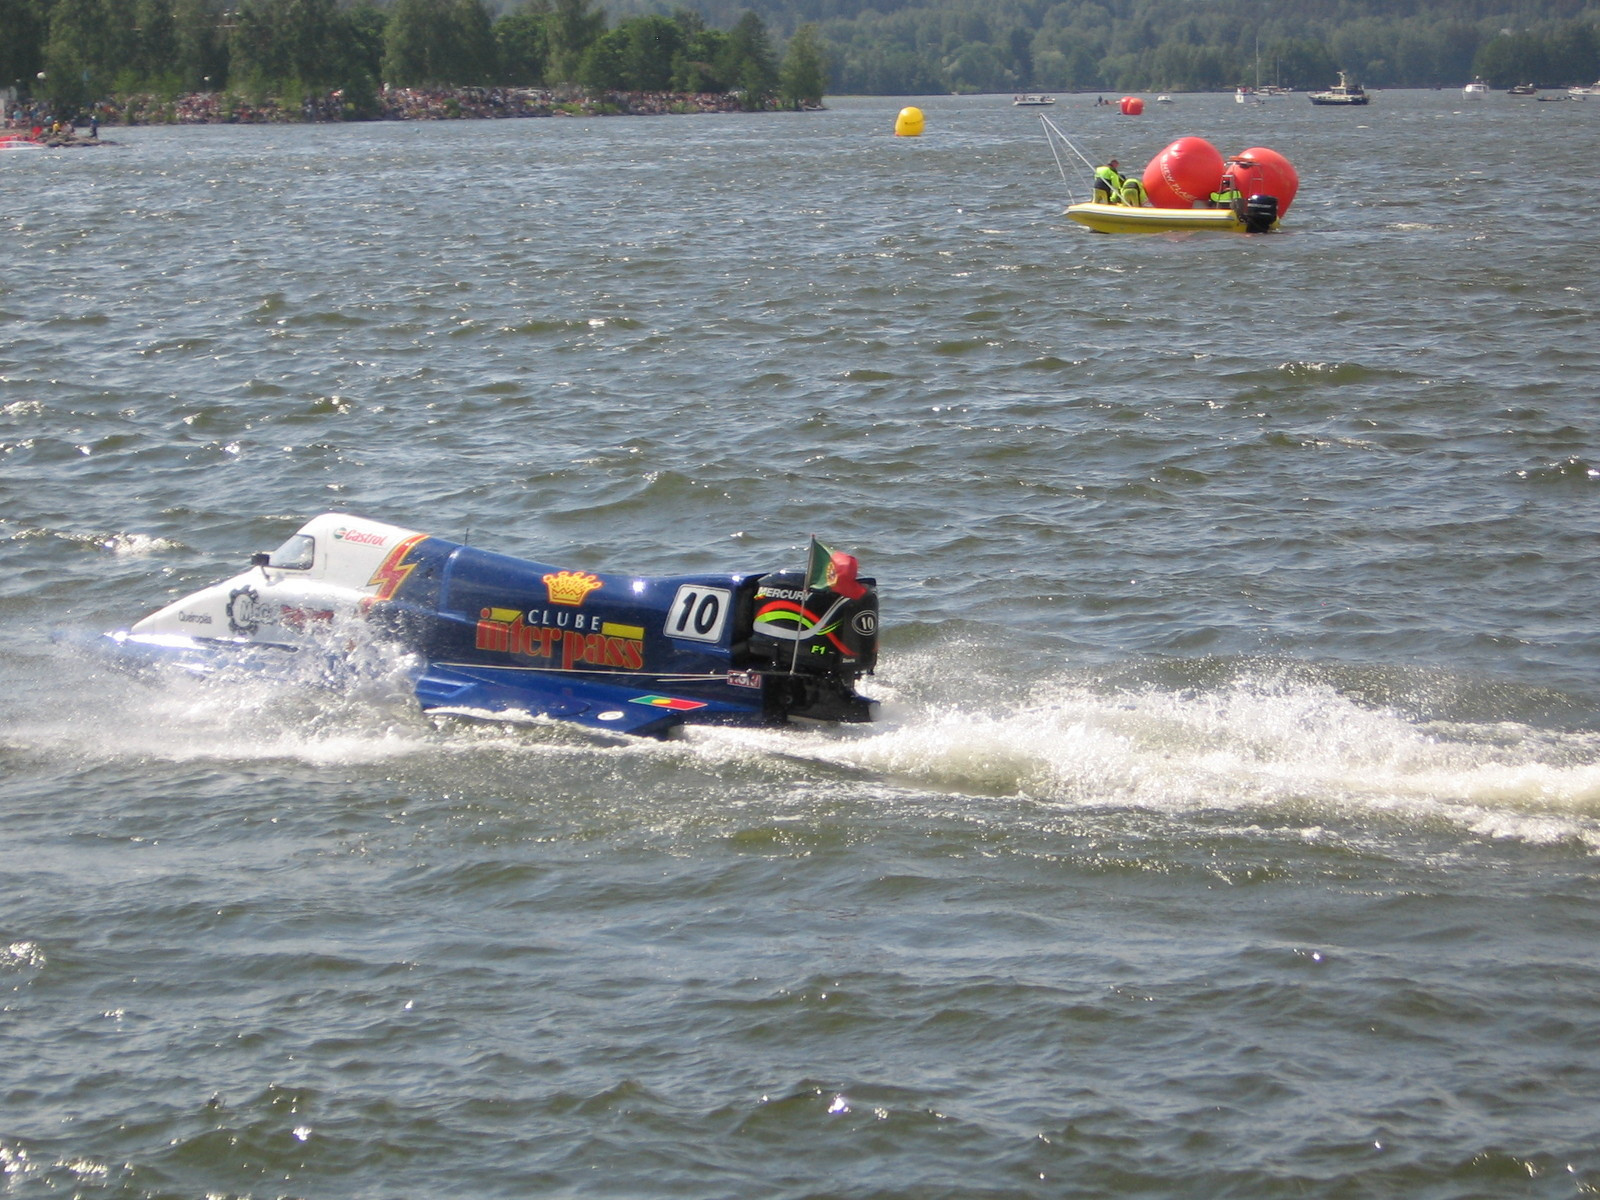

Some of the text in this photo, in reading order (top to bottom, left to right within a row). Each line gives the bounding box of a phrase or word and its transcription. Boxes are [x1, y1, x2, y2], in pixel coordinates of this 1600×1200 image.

[345, 529, 387, 546] Castrol
[757, 586, 812, 601] MERCURY
[527, 609, 601, 631] CLUBE
[676, 592, 718, 635] 10
[861, 617, 874, 630] 10
[811, 645, 826, 655] F1
